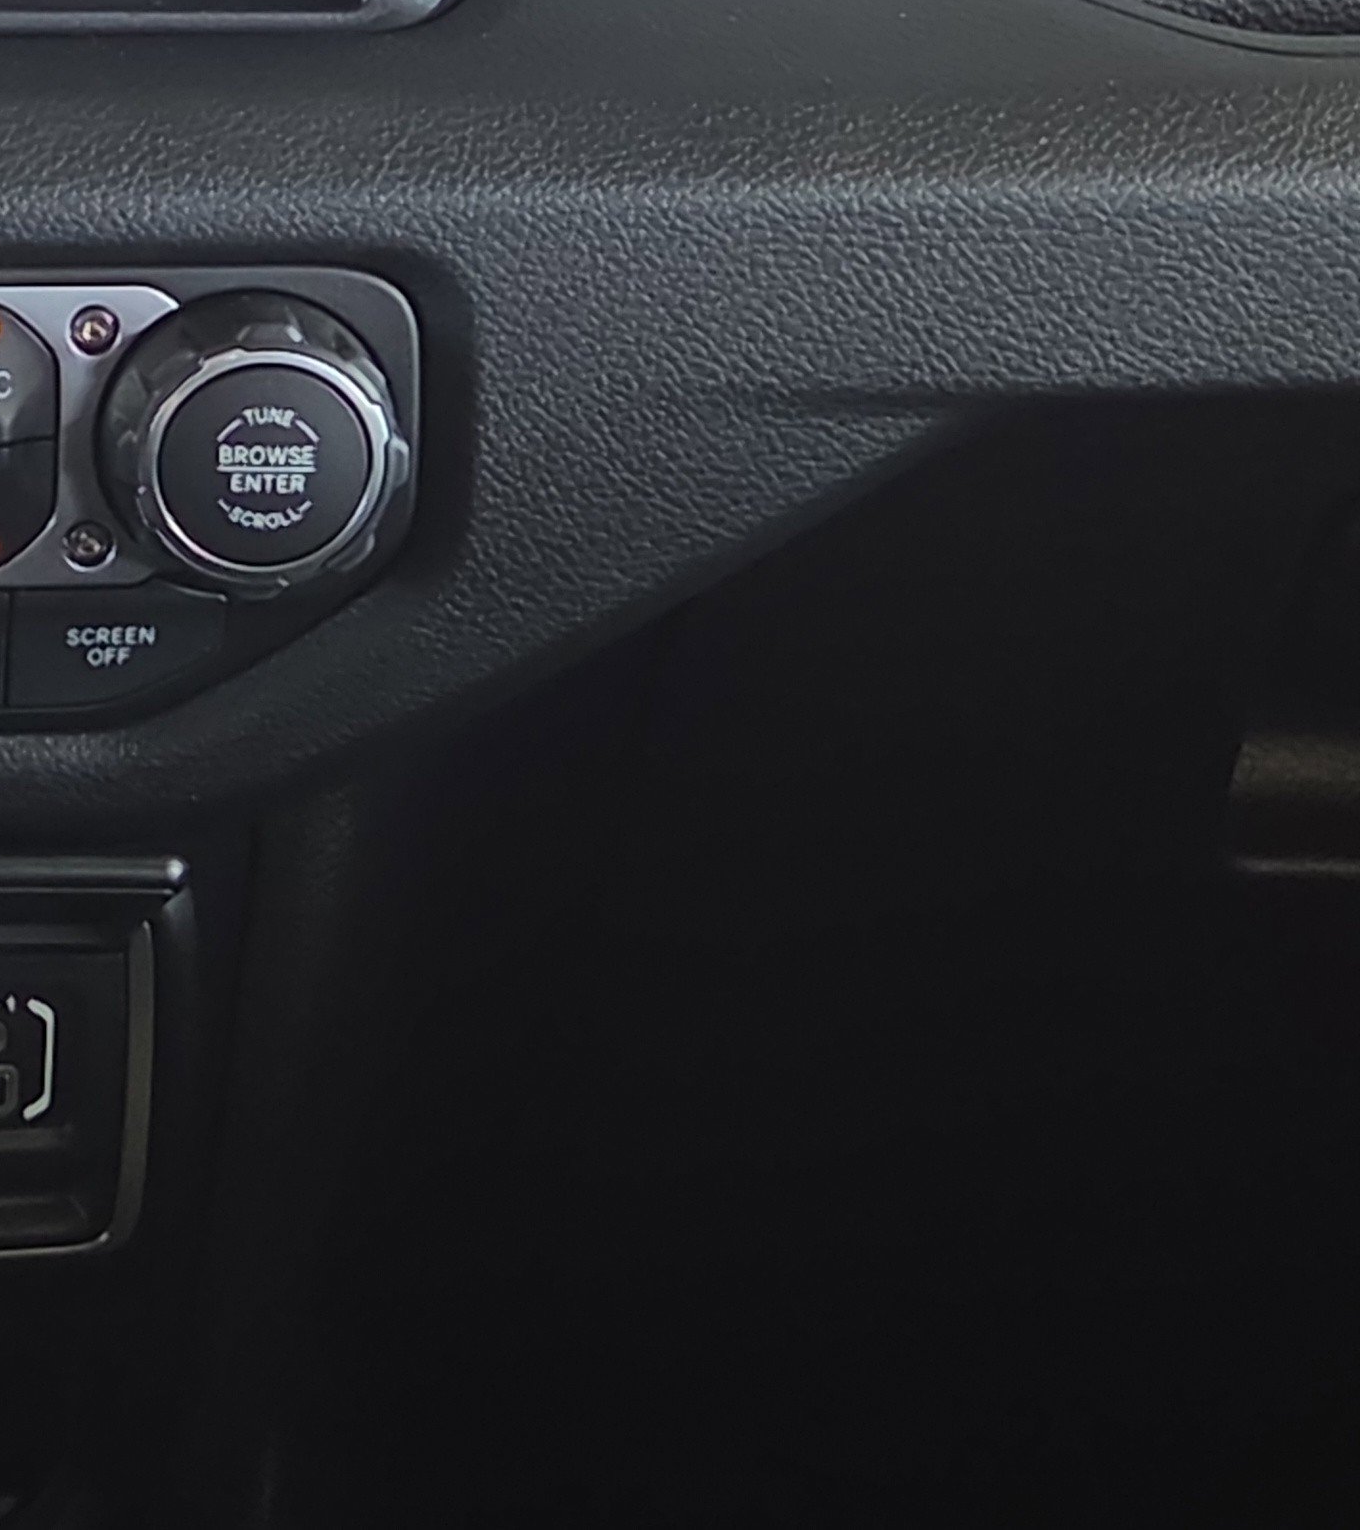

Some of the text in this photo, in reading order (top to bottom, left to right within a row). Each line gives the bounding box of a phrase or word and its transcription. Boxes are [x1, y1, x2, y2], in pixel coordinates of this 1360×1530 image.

[242, 406, 296, 429] TUNE
[218, 445, 316, 467] BROWSE
[229, 473, 306, 495] ENTER
[227, 503, 300, 530] SCROLL
[66, 626, 156, 647] SCREEN
[86, 647, 131, 667] OFF
